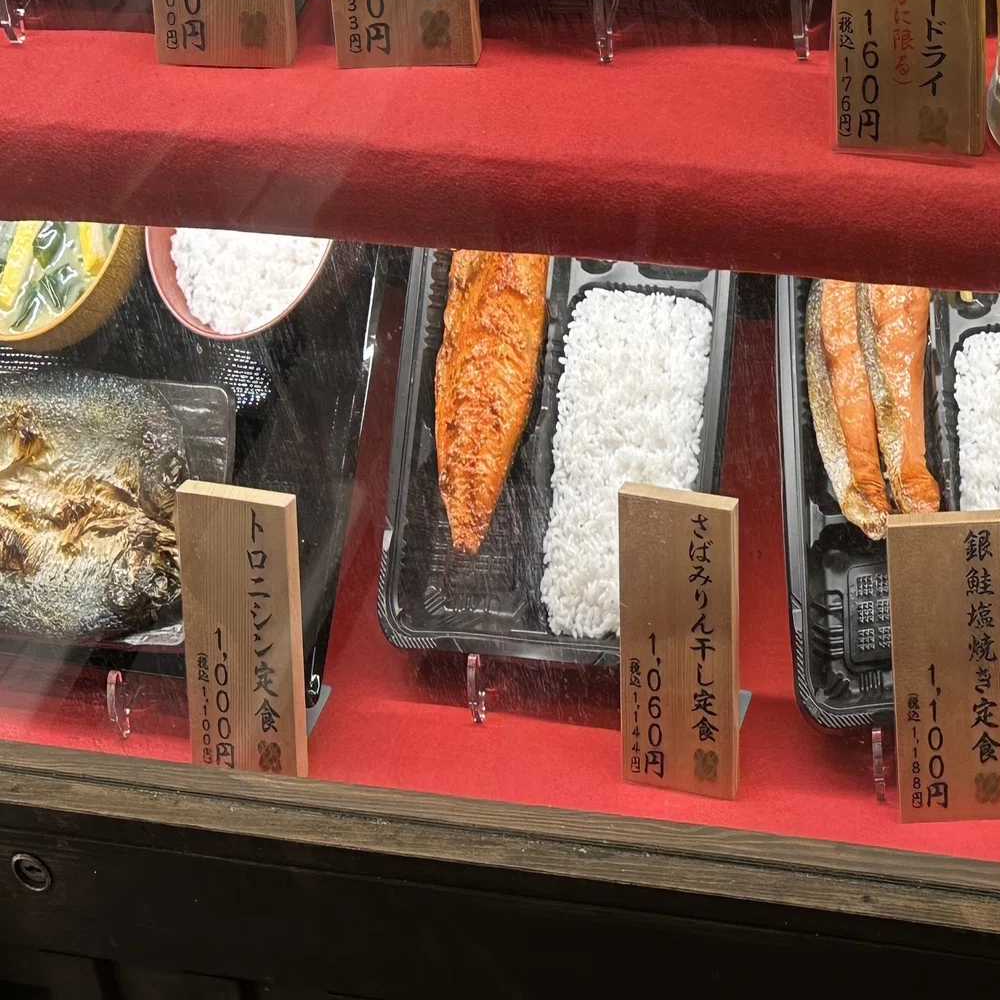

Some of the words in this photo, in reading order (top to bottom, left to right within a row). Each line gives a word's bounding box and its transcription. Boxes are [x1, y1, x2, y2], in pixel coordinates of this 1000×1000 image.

[857, 8, 881, 143] 160円
[246, 507, 281, 734] トロニシン定食
[688, 513, 720, 743] さばみりん干し定食
[214, 627, 235, 769] 1,000円
[644, 632, 665, 779] 1,060円
[926, 663, 949, 810] 1,100円
